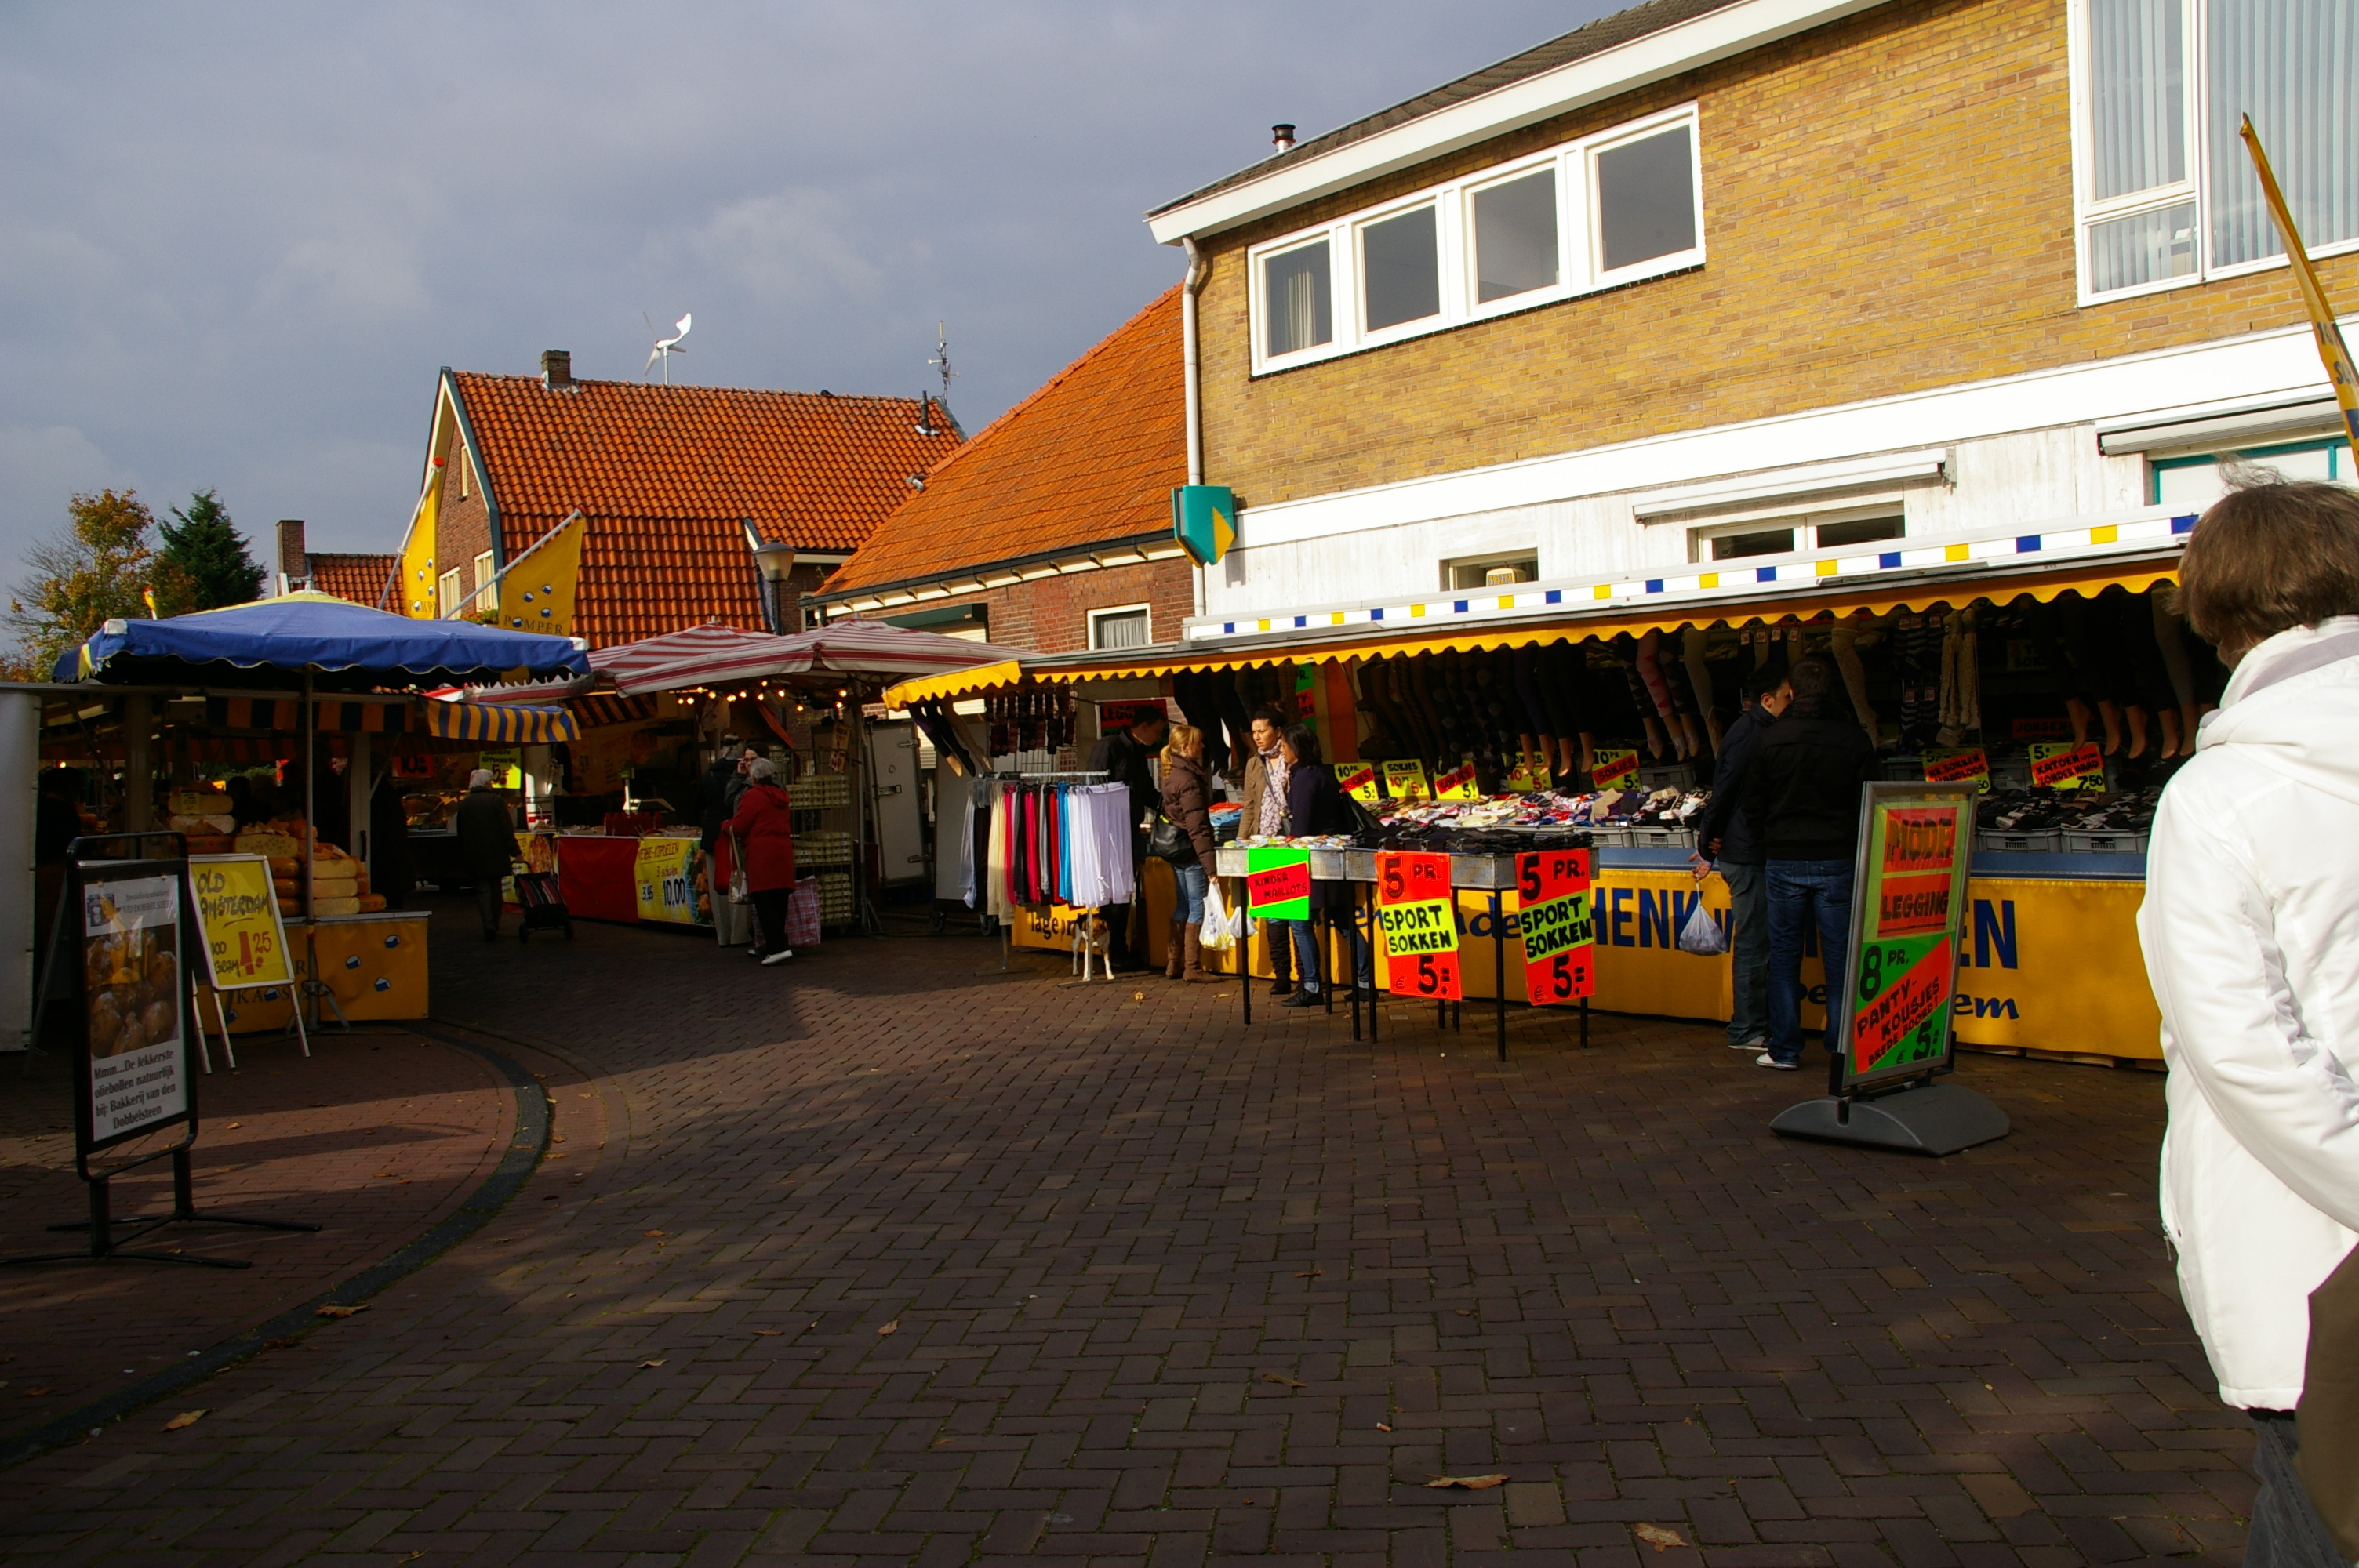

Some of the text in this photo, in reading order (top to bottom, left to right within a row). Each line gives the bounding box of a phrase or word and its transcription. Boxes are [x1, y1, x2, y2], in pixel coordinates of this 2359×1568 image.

[1337, 765, 1350, 778] 10
[1387, 763, 1419, 772] SOKJES
[1598, 757, 1637, 782] SOKJES
[2035, 753, 2080, 775] KATOEN
[1388, 776, 1402, 787] 10
[198, 868, 227, 894] OLD
[1255, 871, 1289, 888] KINDER
[1384, 857, 1405, 900] 5
[1521, 854, 1543, 901] 5
[1263, 884, 1308, 900] MAILLOTS
[1881, 889, 1950, 921] LEGGING
[200, 892, 272, 928] AMSTERDAM
[1384, 905, 1443, 932] SPORT
[1521, 896, 1583, 935] SPORT
[1389, 931, 1452, 953] SOKKEN
[1525, 918, 1594, 959] SOKKEN
[1859, 945, 1882, 1002] 8
[1881, 976, 1940, 1041] KOUSJES
[137, 1050, 174, 1068] lekkerste
[95, 1065, 175, 1098] oliebollen natuurlijk
[110, 1091, 145, 1112] Bakkerij
[146, 1088, 160, 1100] van
[162, 1083, 176, 1095] den
[113, 1105, 162, 1129] Dobbelsteen
